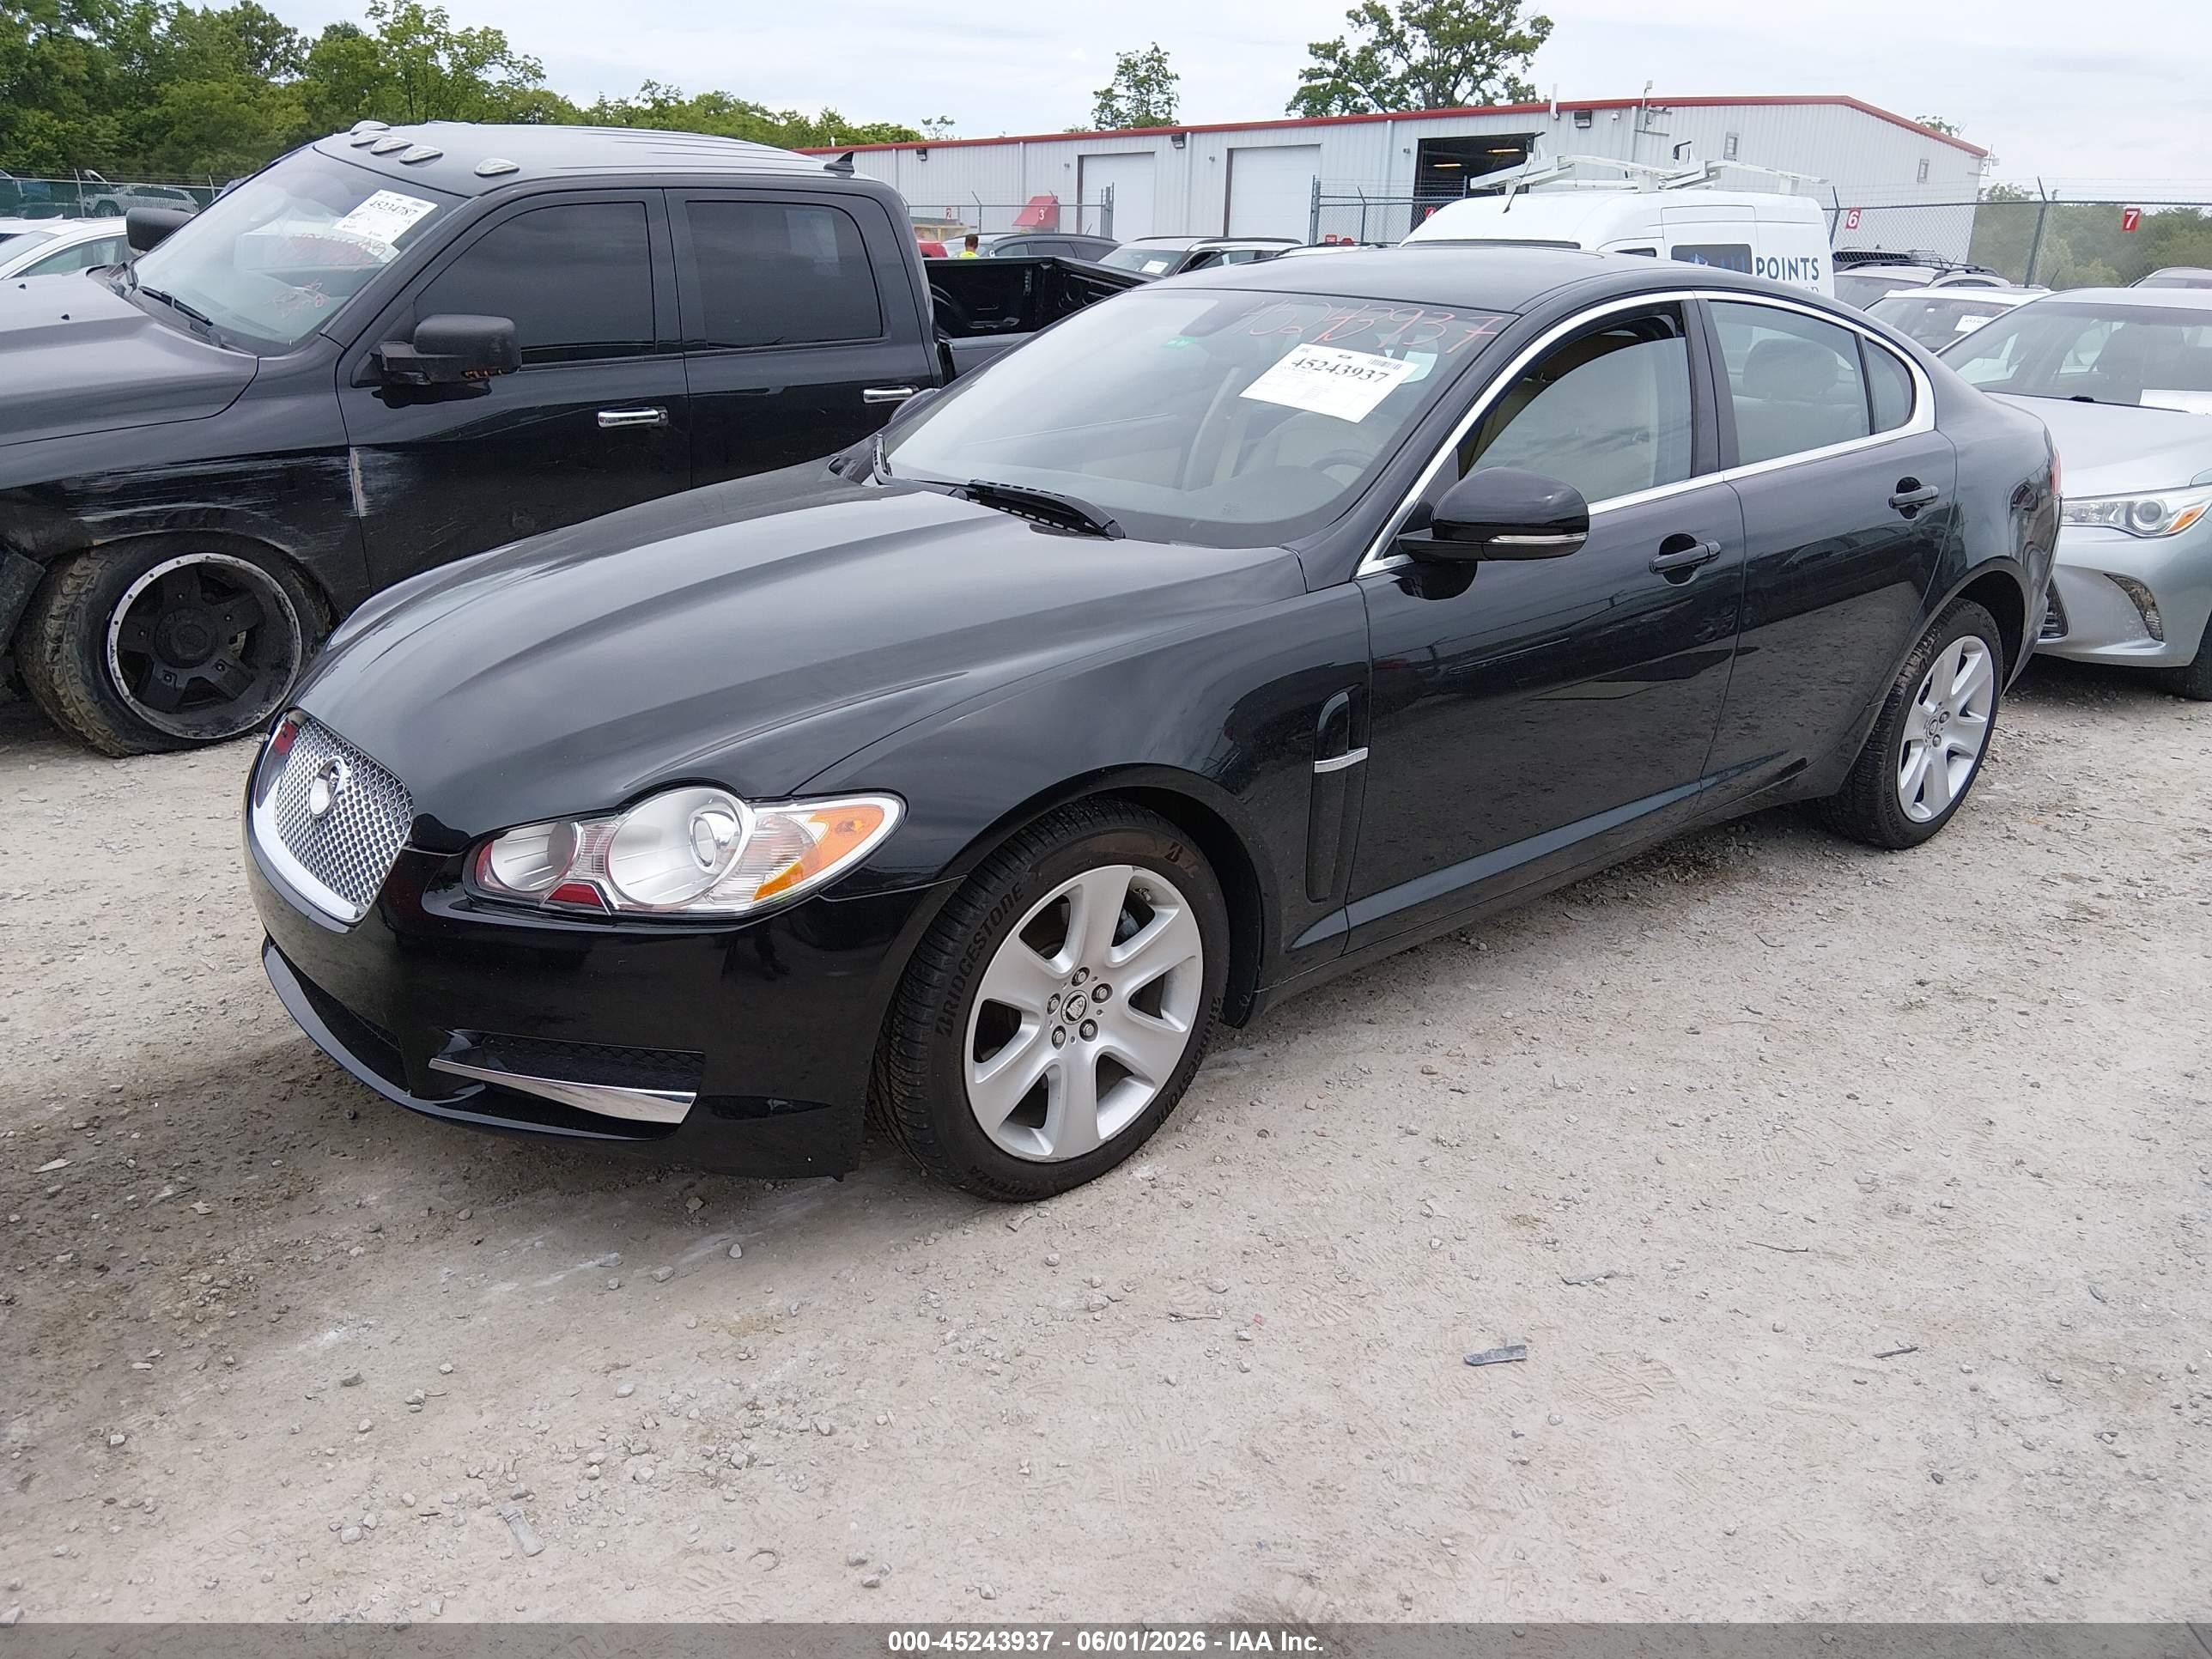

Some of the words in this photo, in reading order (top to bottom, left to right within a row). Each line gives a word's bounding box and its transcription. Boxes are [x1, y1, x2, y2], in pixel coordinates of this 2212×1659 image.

[1038, 208, 1046, 221] 3
[1848, 210, 1860, 228] 6
[2125, 210, 2139, 229] 7
[1755, 256, 1820, 282] POINTS
[1291, 356, 1390, 384] 45243937
[934, 882, 1024, 1038] BRIDGESTONE
